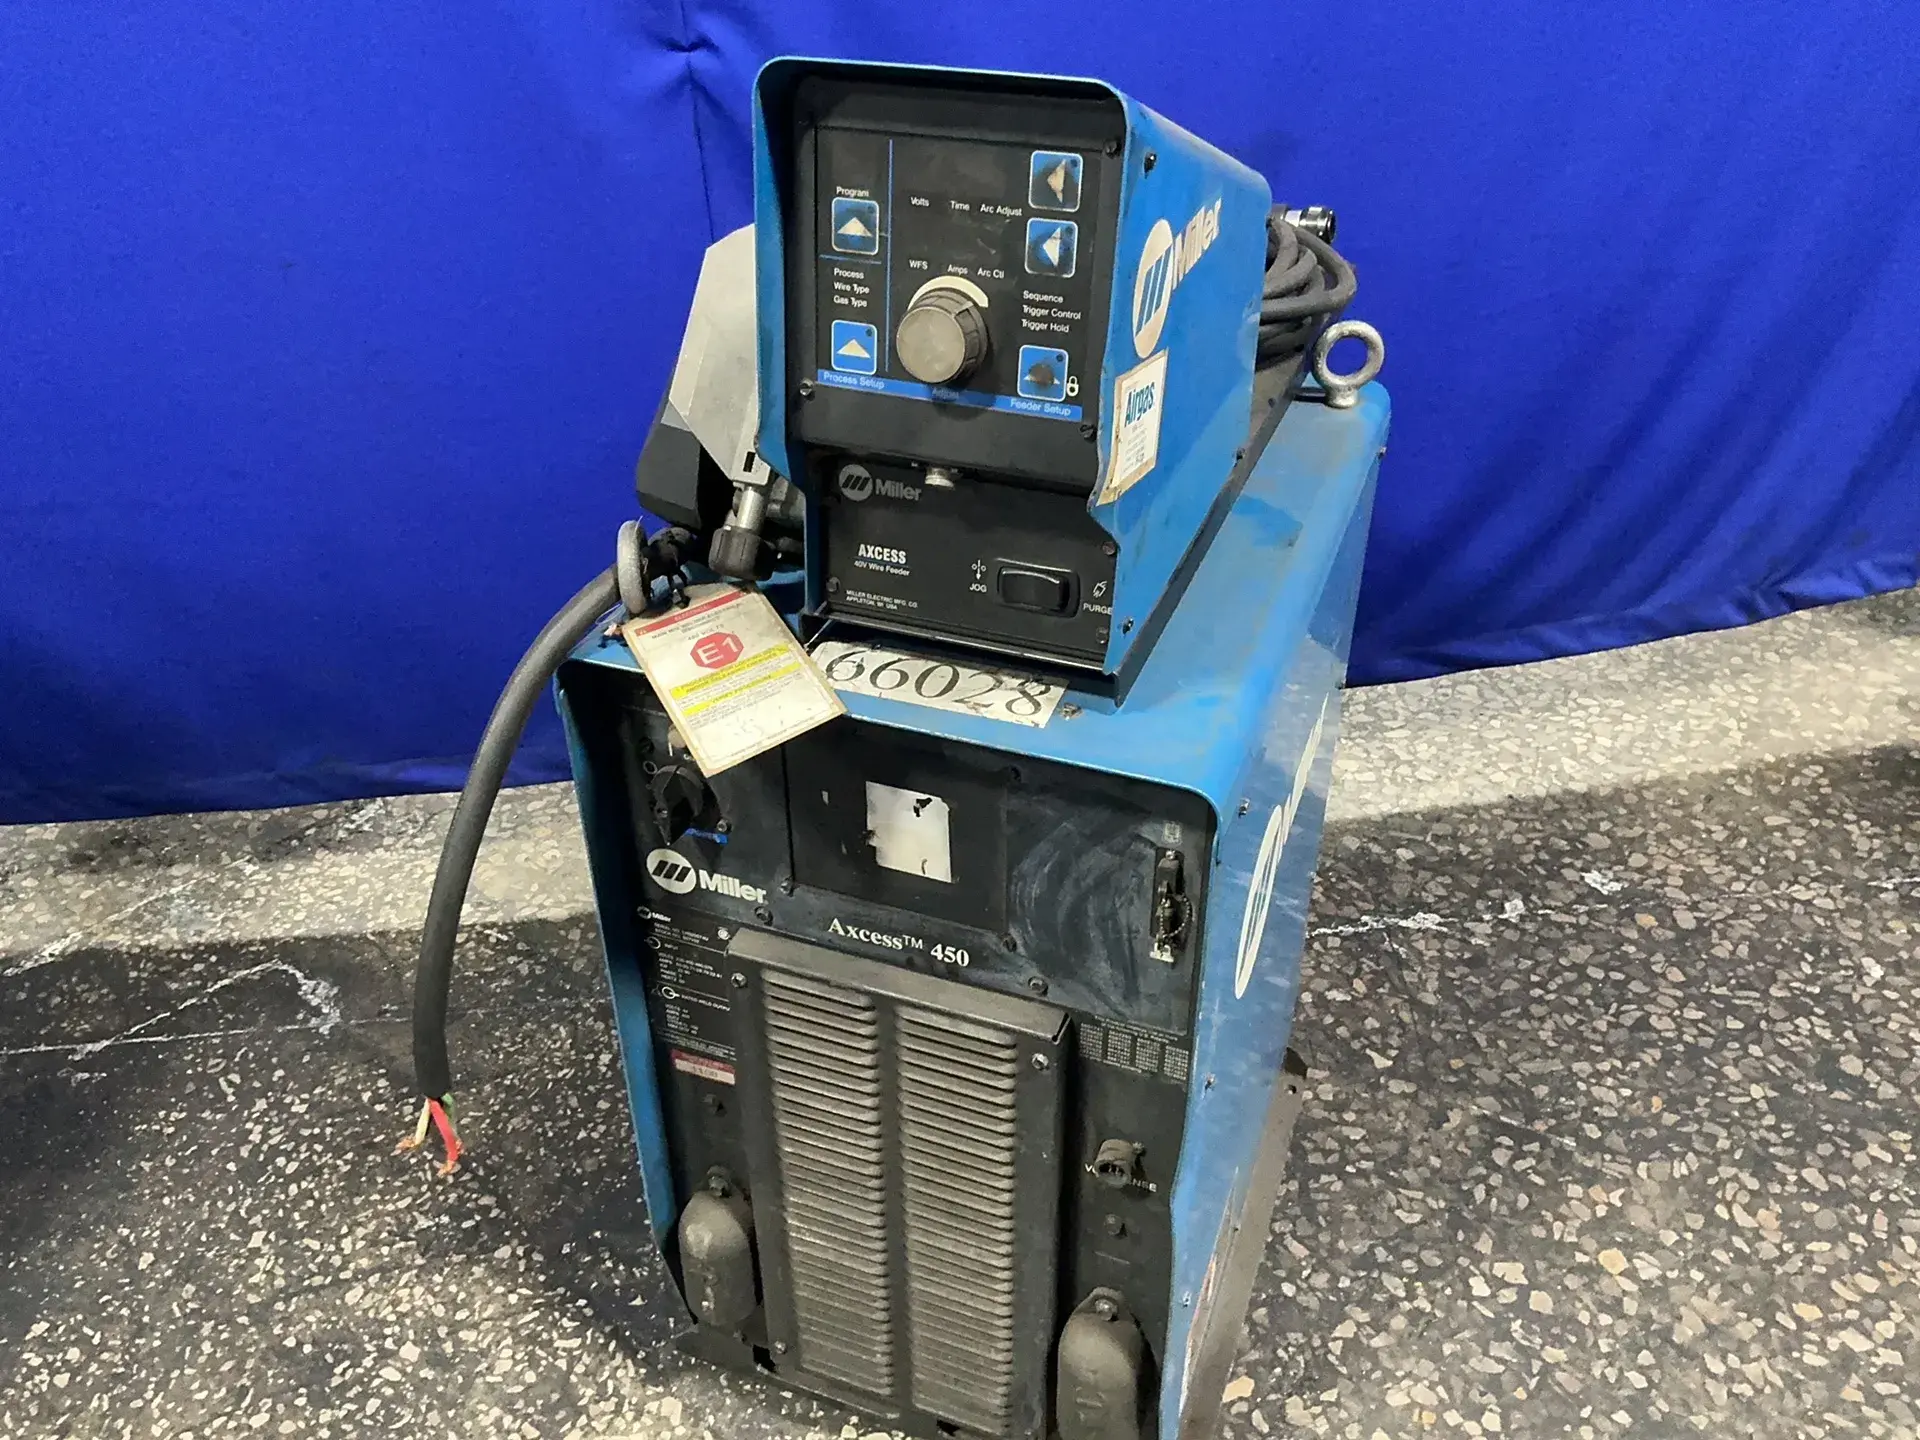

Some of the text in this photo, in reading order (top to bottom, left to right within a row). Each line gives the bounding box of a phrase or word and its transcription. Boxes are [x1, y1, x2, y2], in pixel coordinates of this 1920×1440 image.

[836, 186, 870, 198] Program
[910, 197, 930, 207] Volts
[950, 200, 970, 211] Time
[980, 203, 1022, 217] Arc Adjust
[909, 259, 928, 270] WFS
[947, 263, 968, 276] Amps
[833, 268, 864, 279] Process
[977, 267, 1004, 279] Arc Ctl
[833, 282, 870, 295] Wire Type
[833, 295, 868, 308] Gas Type
[1023, 290, 1064, 304] Sequence
[1022, 304, 1082, 320] Trigger Control
[1021, 318, 1070, 333] Trigger Hold
[823, 371, 885, 390] Process Setup
[1010, 397, 1071, 417] Feeder Setup
[1124, 382, 1155, 428] Airgas
[875, 479, 922, 501] Miller
[858, 543, 907, 565] AXCESS
[868, 562, 885, 572] Wire
[885, 565, 910, 576] Feeder
[969, 582, 987, 594] JOG
[846, 589, 866, 598] MILLER
[866, 593, 894, 604] ELECTRIC
[1083, 603, 1113, 616] PURGE
[696, 636, 740, 666] E1
[825, 650, 1051, 716] 66028
[699, 869, 768, 903] Miller
[930, 943, 970, 967] 450
